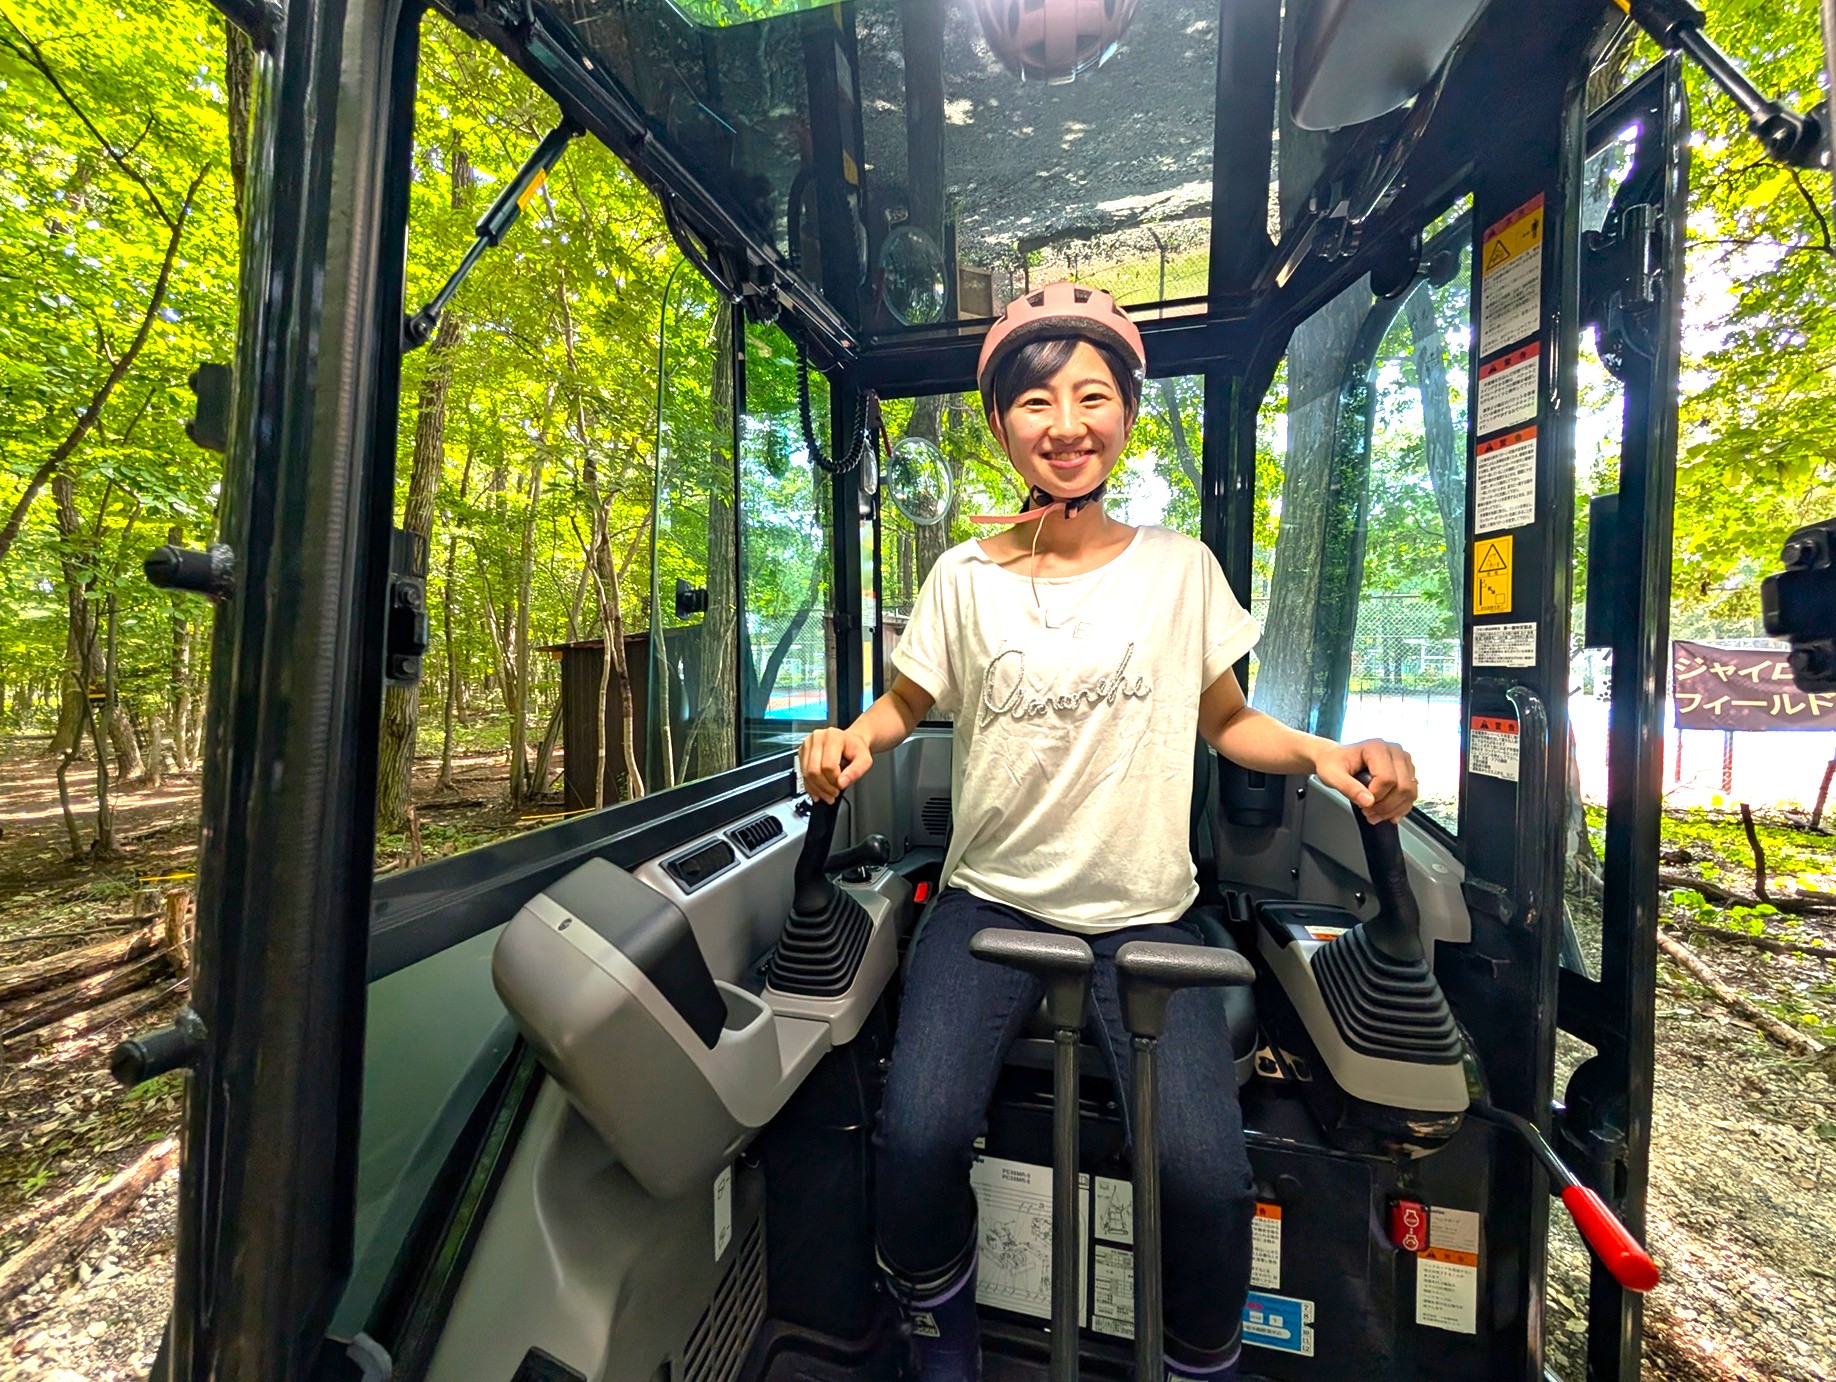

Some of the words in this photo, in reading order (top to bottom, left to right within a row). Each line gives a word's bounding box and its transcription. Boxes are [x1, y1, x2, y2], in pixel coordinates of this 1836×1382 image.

[1675, 692, 1836, 716] フィールド
